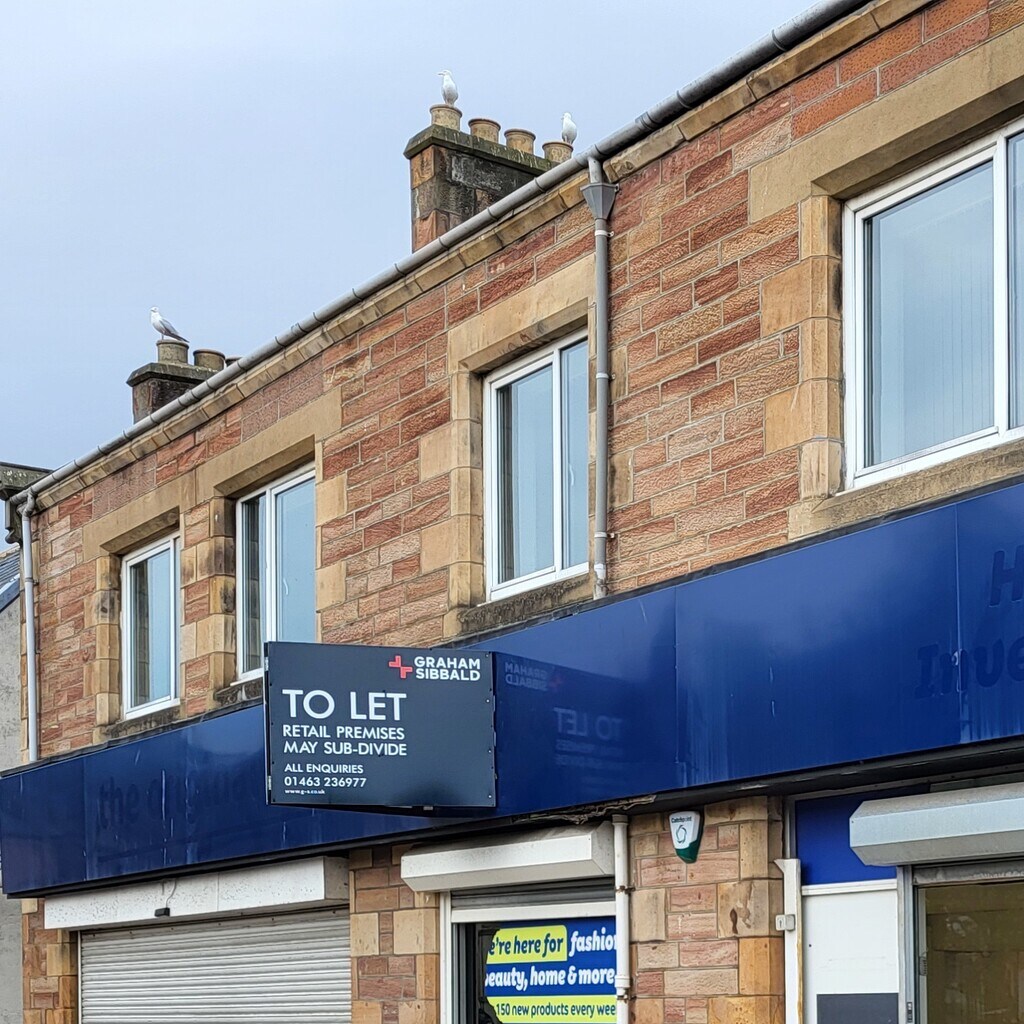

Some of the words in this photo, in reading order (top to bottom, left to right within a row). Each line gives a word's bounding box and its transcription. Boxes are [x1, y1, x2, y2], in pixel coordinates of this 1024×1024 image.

[414, 656, 481, 670] GRAHAM
[415, 668, 481, 682] SIBBALD
[282, 689, 335, 719] TO
[350, 691, 407, 721] LET
[282, 725, 331, 738] RETAIL
[336, 726, 405, 740] PREMISES
[283, 741, 318, 754] MAY
[323, 742, 408, 756] SUB-DIVIDE
[284, 763, 304, 773] ALL
[306, 763, 364, 774] ENQUIRIES
[284, 776, 321, 786] 01463
[323, 777, 367, 787] 236977
[488, 936, 511, 955] e're
[513, 935, 541, 954] here
[541, 933, 563, 958] for
[530, 965, 565, 986] home
[567, 965, 578, 985] &
[578, 968, 615, 985] more
[496, 1002, 510, 1016] 150
[512, 1004, 530, 1016] new
[530, 1002, 569, 1019] products
[570, 1004, 595, 1019] every
[596, 1004, 616, 1016] wee
